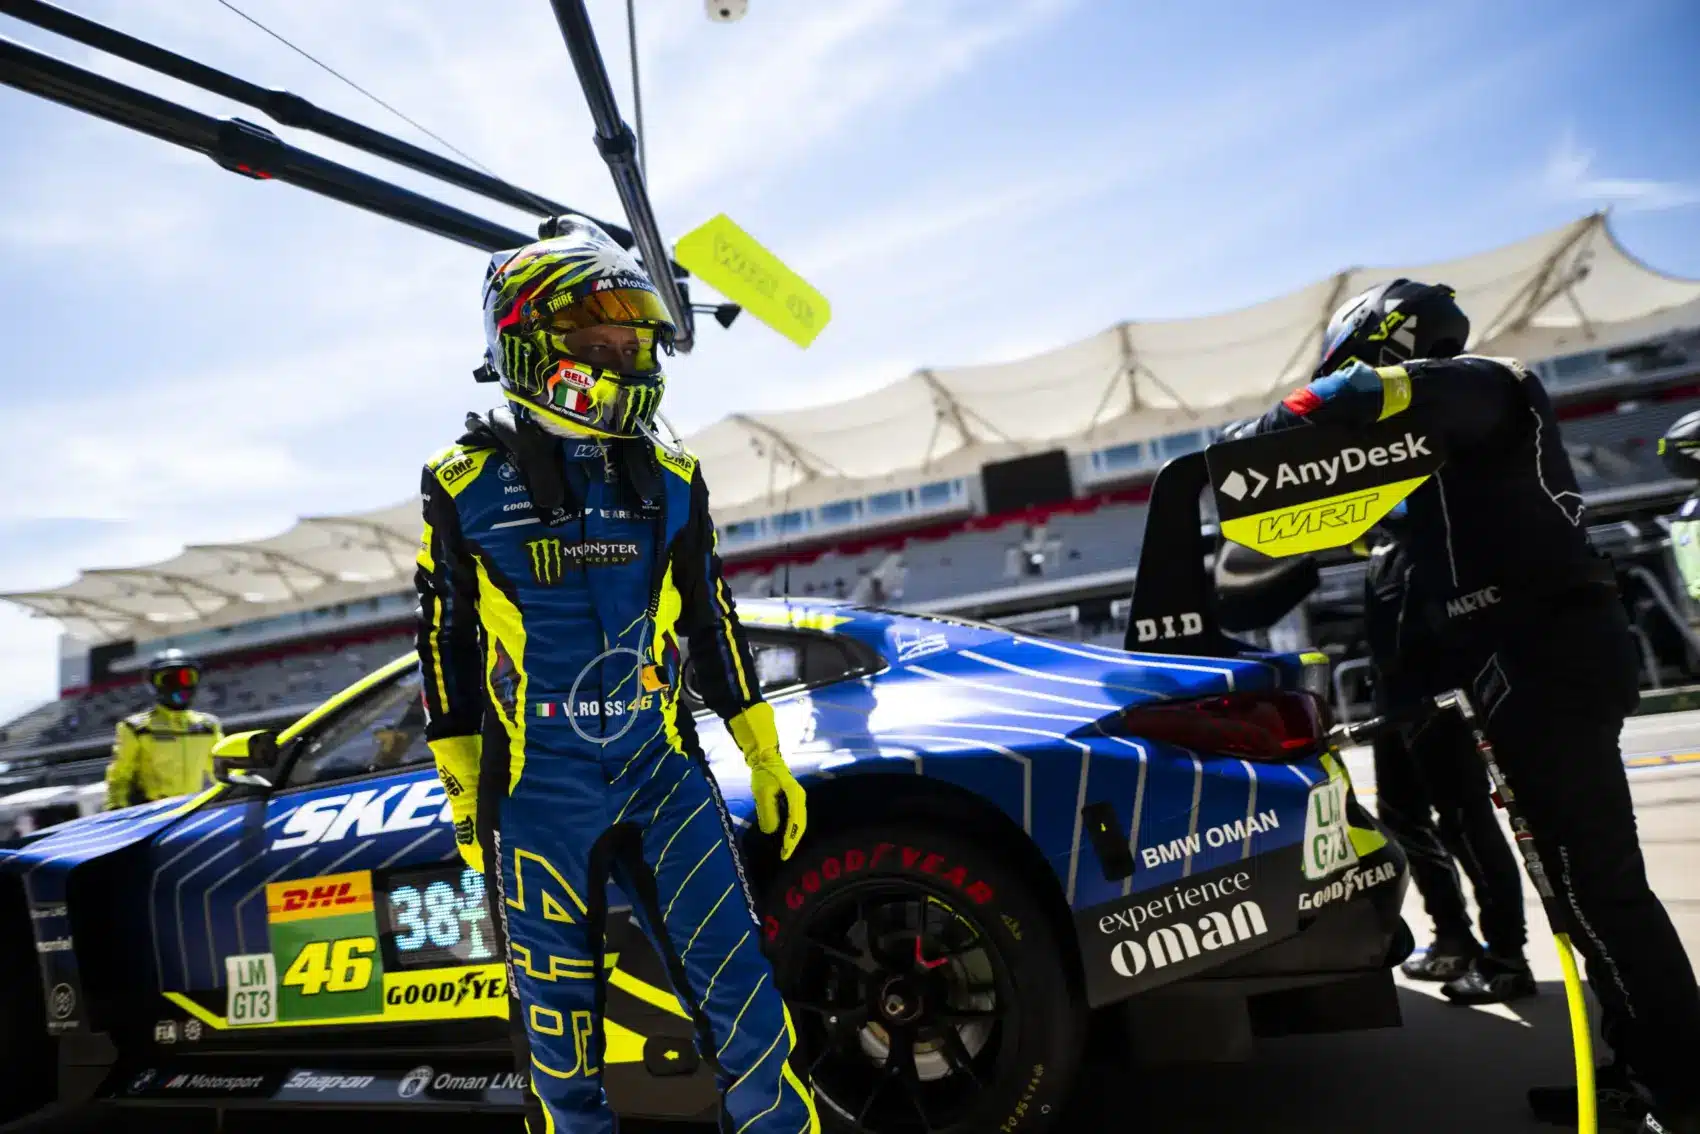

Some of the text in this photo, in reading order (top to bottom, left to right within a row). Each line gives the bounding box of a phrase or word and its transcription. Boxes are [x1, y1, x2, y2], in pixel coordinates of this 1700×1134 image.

[564, 370, 591, 386] BELL
[443, 458, 475, 482] OMP
[1275, 432, 1432, 490] AnyDesk
[1257, 492, 1380, 545] WRT
[563, 542, 638, 558] MONSTER
[575, 556, 627, 564] ENERGY
[1135, 612, 1203, 643] D.I.D
[626, 695, 653, 712] 46
[1141, 809, 1280, 869] BMW OMAN
[281, 882, 361, 913] DHL
[1298, 861, 1397, 911] GOODYEAR
[1099, 871, 1250, 934] experience
[1110, 900, 1268, 977] oman
[235, 959, 268, 988] LM
[282, 935, 378, 996] 46
[233, 990, 271, 1020] GT3
[186, 1074, 264, 1091] Motorsport
[284, 1072, 375, 1092] Snap-on
[433, 1074, 488, 1089] Oman
